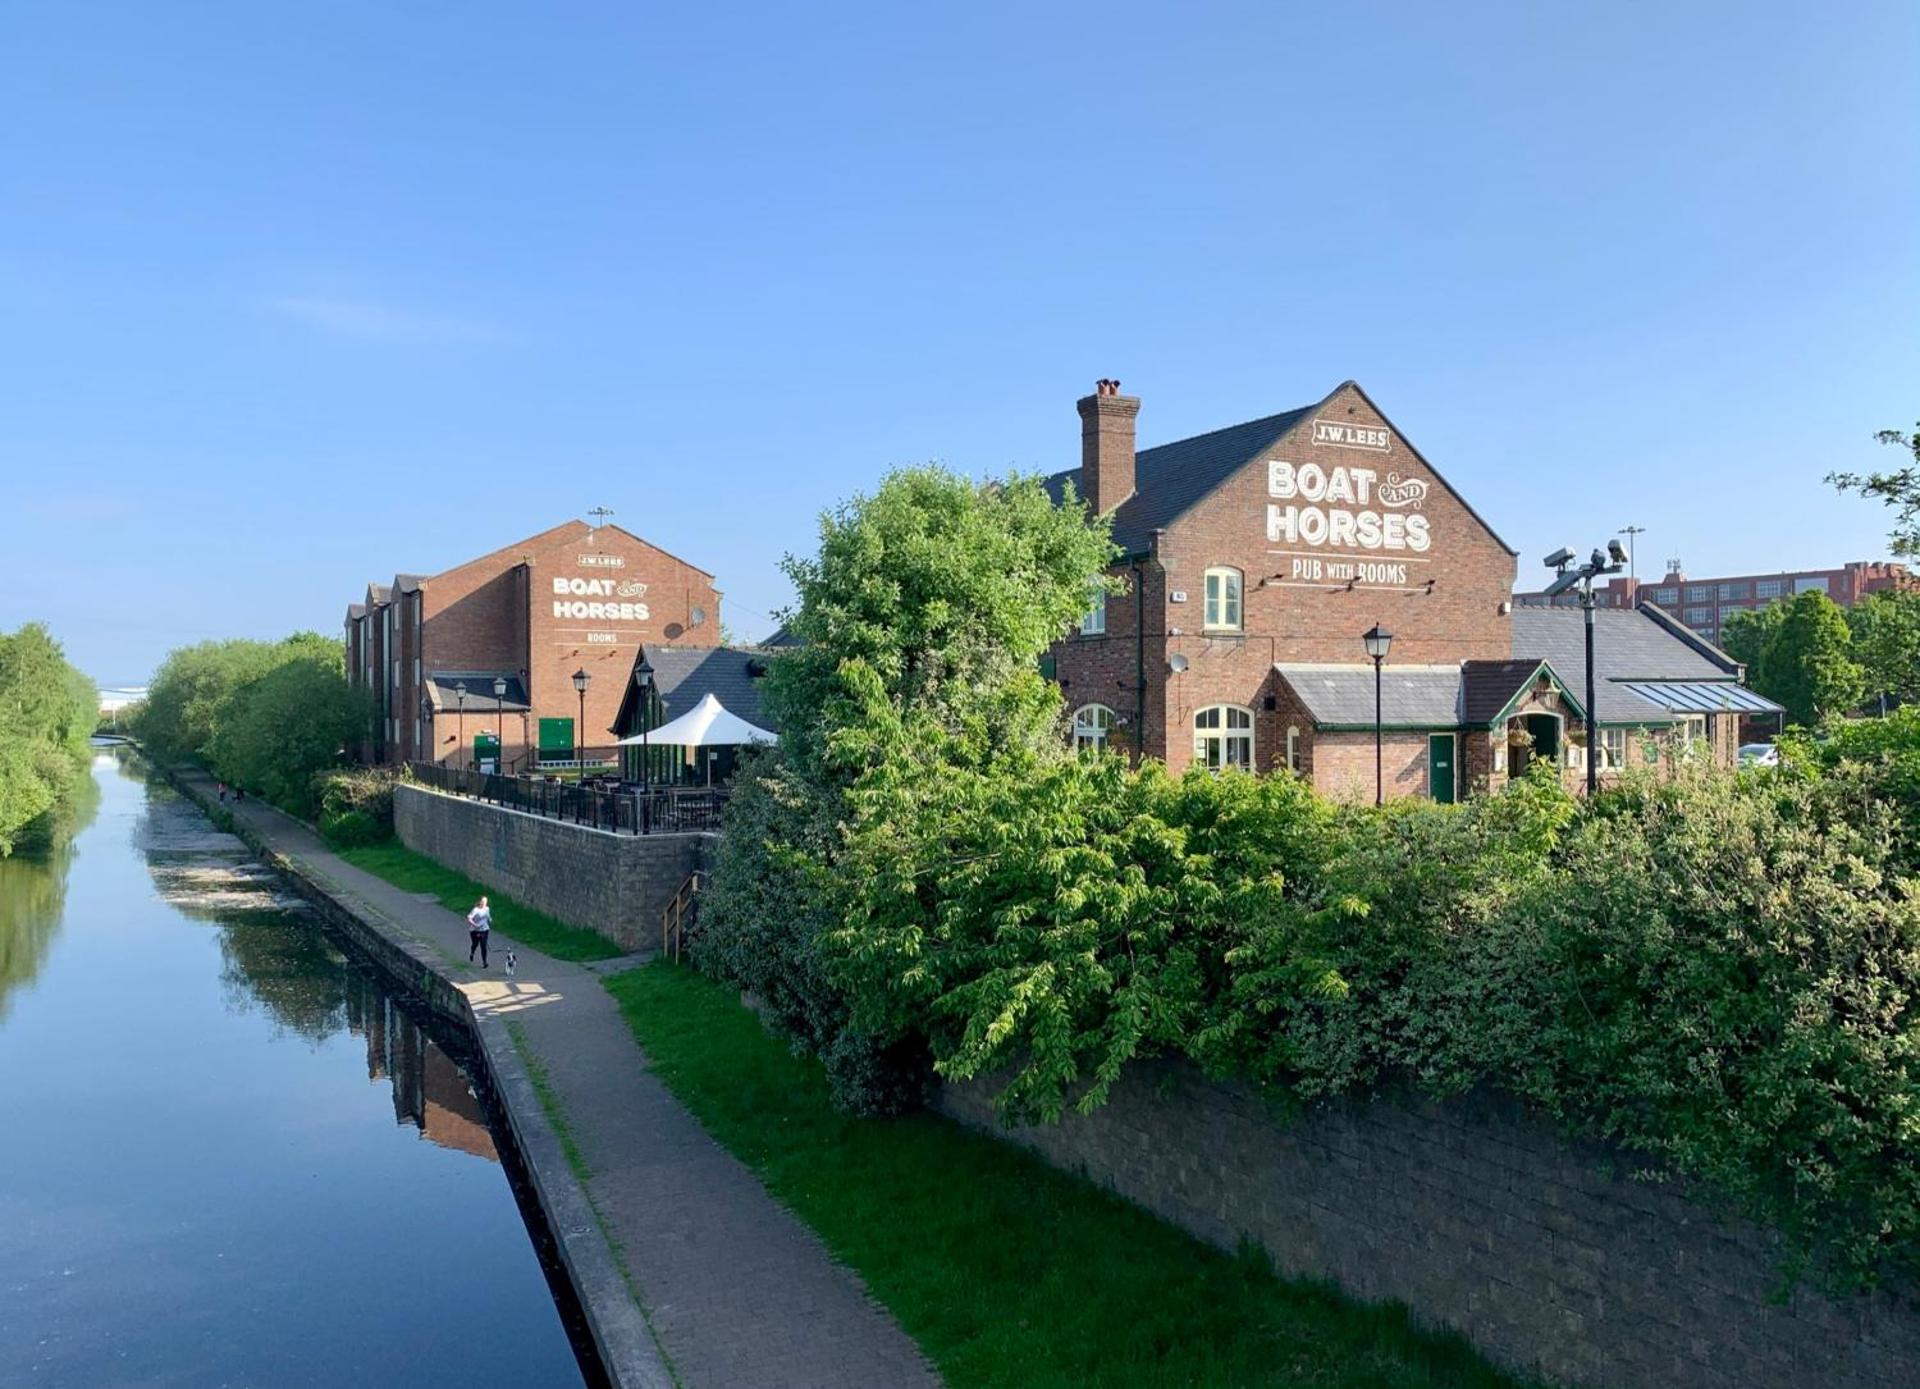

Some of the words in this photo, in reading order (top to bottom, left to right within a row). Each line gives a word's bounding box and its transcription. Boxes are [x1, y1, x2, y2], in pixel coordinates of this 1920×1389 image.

[1268, 460, 1377, 505] BOAT
[1266, 504, 1431, 552] HORSES
[1292, 559, 1322, 580] PUB
[1326, 563, 1354, 579] WITH
[1359, 563, 1407, 584] ROOMS
[553, 577, 616, 596] BOAT
[553, 601, 650, 621] HORSES
[587, 633, 617, 643] ROOMS
